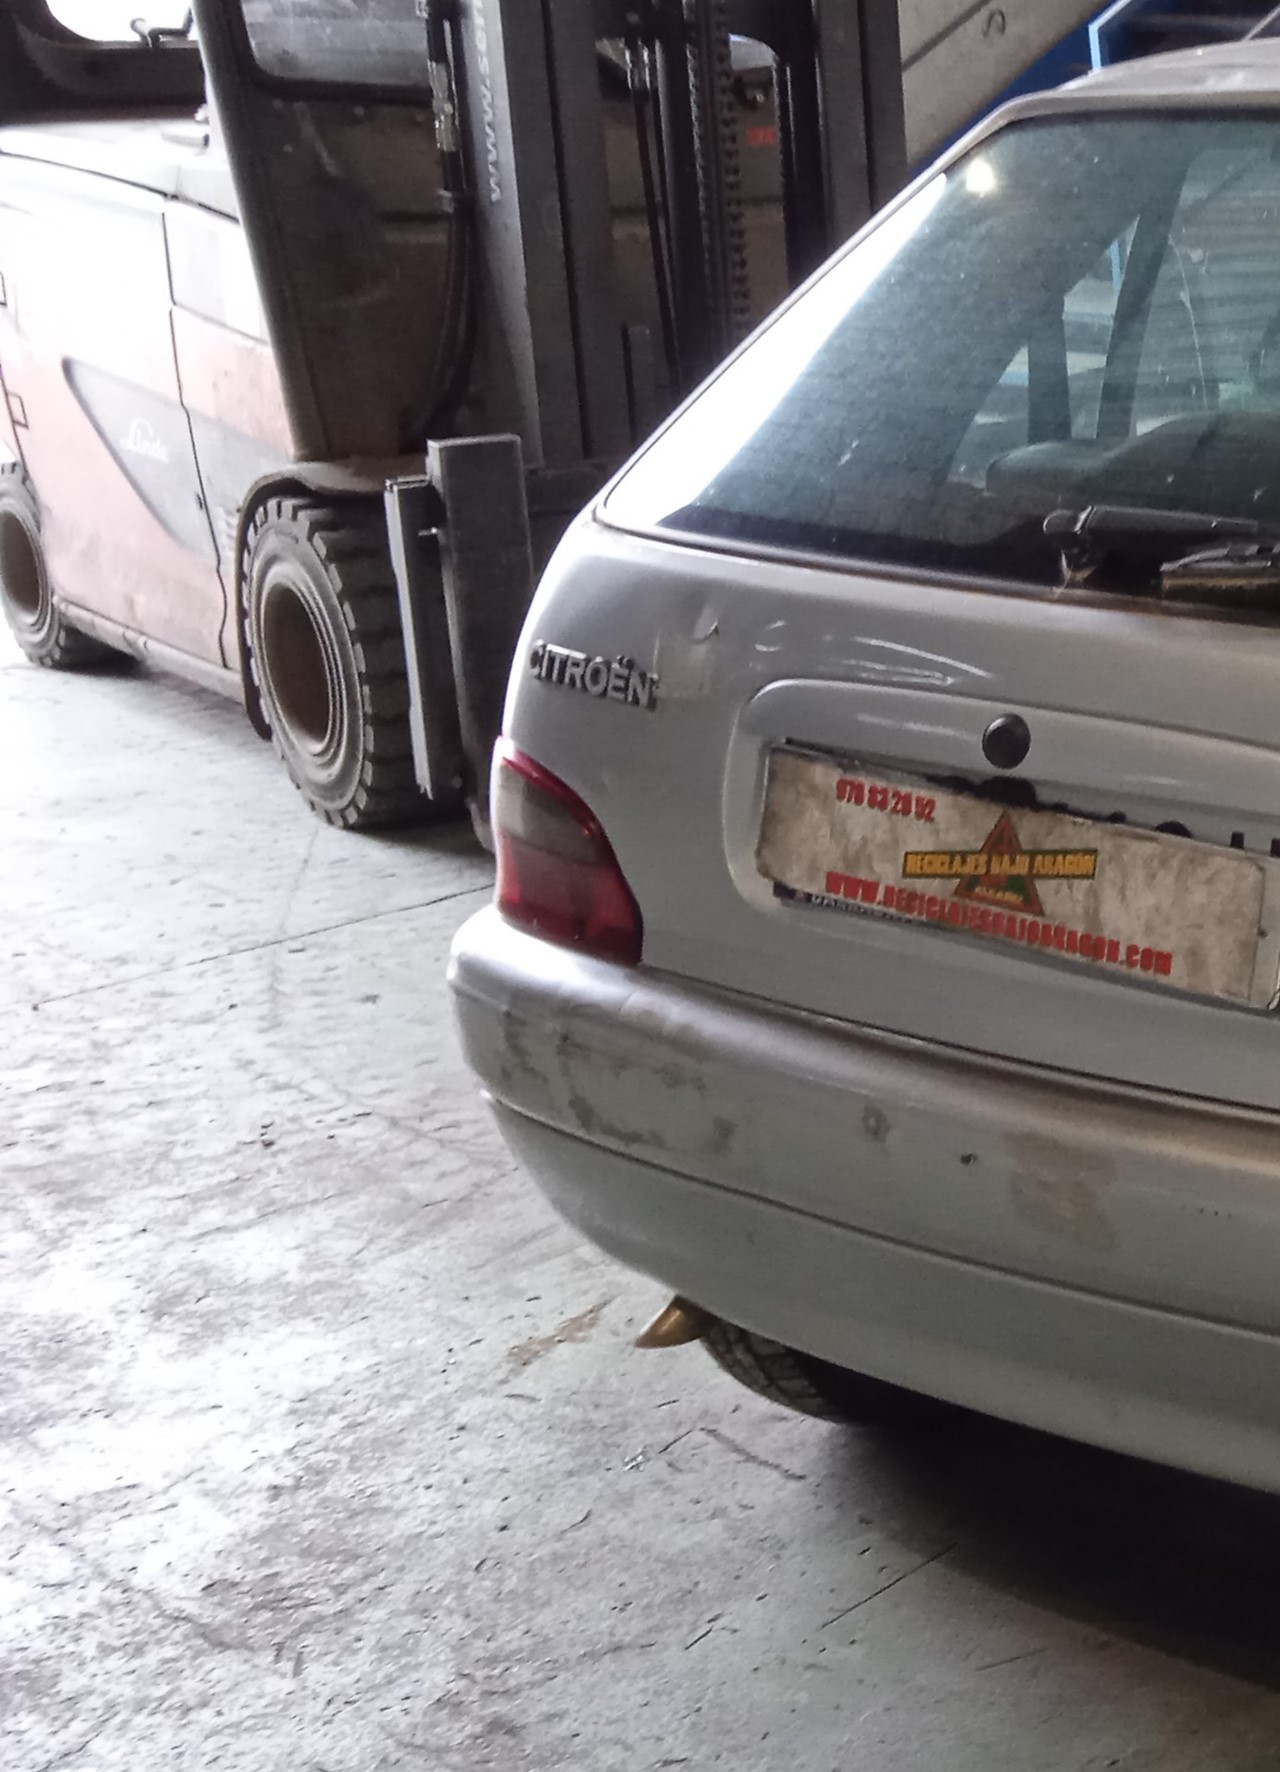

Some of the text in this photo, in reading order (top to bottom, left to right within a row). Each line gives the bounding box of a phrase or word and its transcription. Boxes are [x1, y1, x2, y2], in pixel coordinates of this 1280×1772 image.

[119, 416, 169, 464] Linde
[528, 638, 656, 708] CITROËN
[905, 853, 988, 876] RECICLAJES
[989, 853, 1030, 875] BAJO
